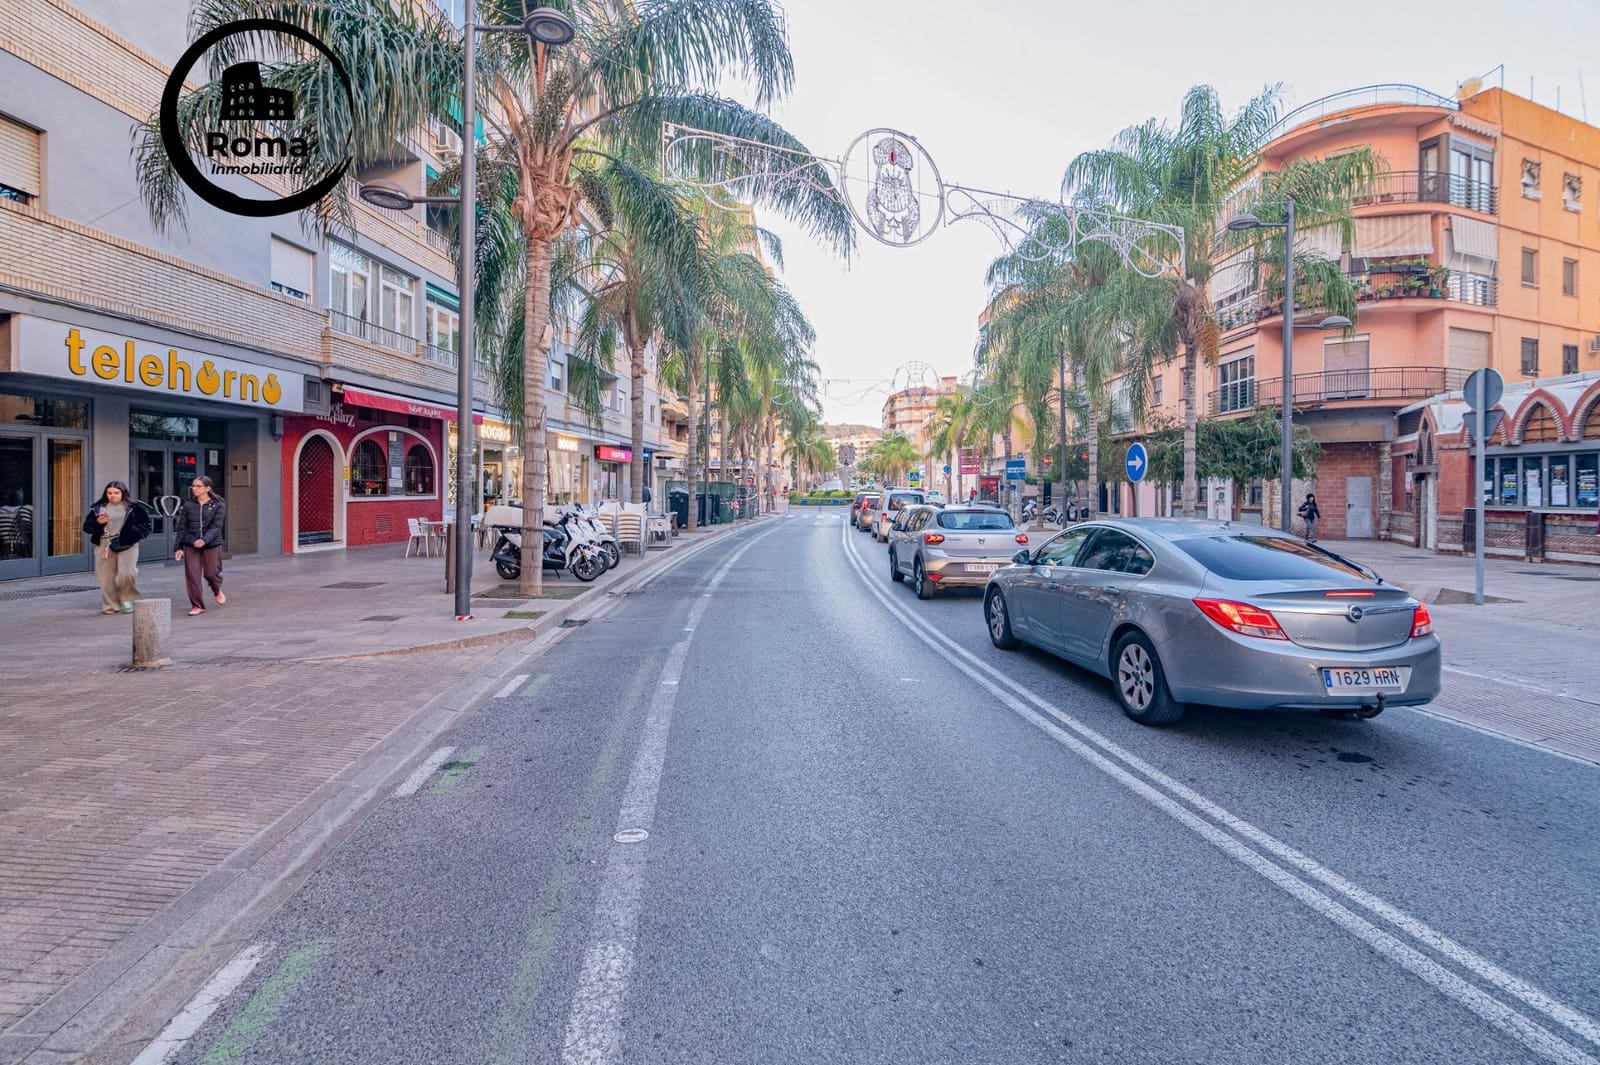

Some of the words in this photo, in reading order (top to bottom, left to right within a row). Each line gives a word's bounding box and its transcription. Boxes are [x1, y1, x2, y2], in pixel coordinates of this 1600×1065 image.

[65, 328, 282, 405] telehorno
[1336, 670, 1371, 686] 1629
[1374, 670, 1398, 685] HRN
